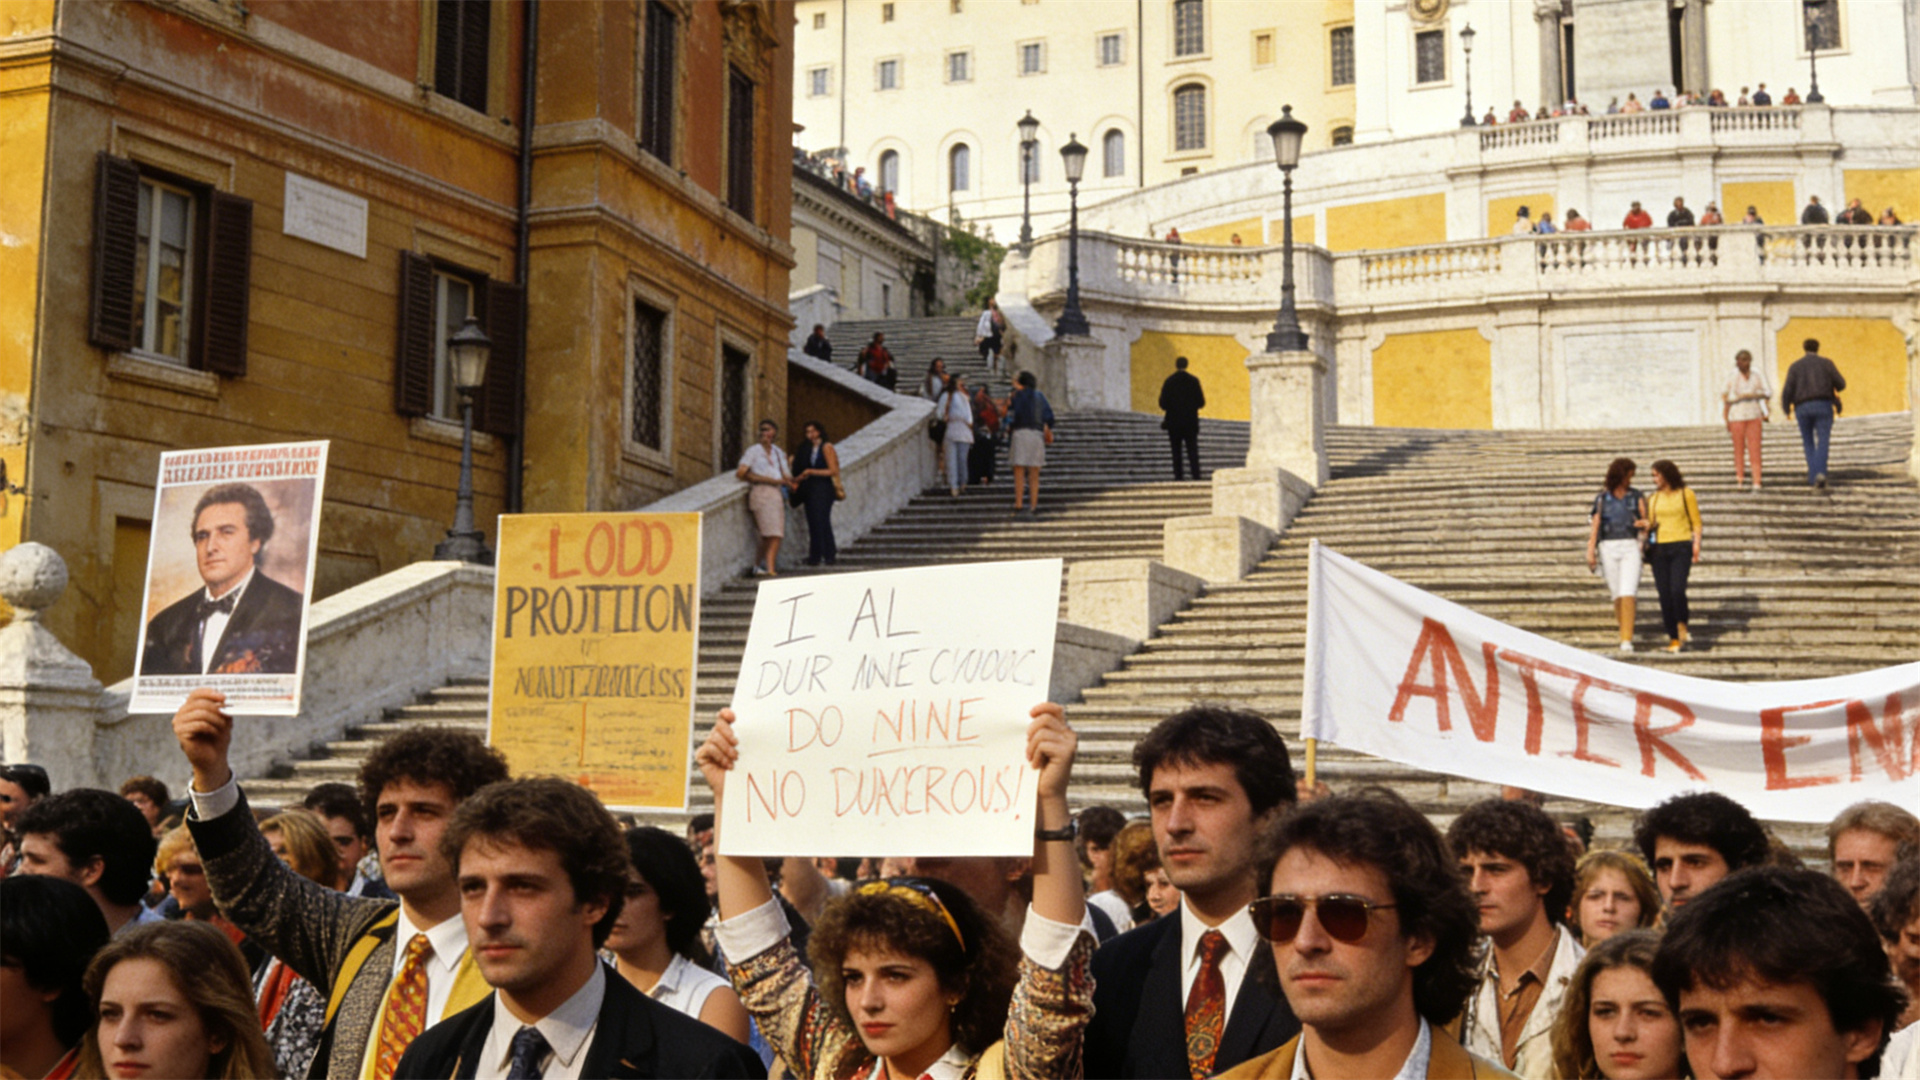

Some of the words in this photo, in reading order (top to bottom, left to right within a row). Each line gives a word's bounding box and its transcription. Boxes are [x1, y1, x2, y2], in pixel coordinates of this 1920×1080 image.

[773, 592, 816, 648] I
[848, 586, 920, 642] AL
[755, 654, 833, 700] DUR
[784, 705, 844, 753] DO
[872, 697, 986, 744] NINE
[746, 769, 806, 823] NO
